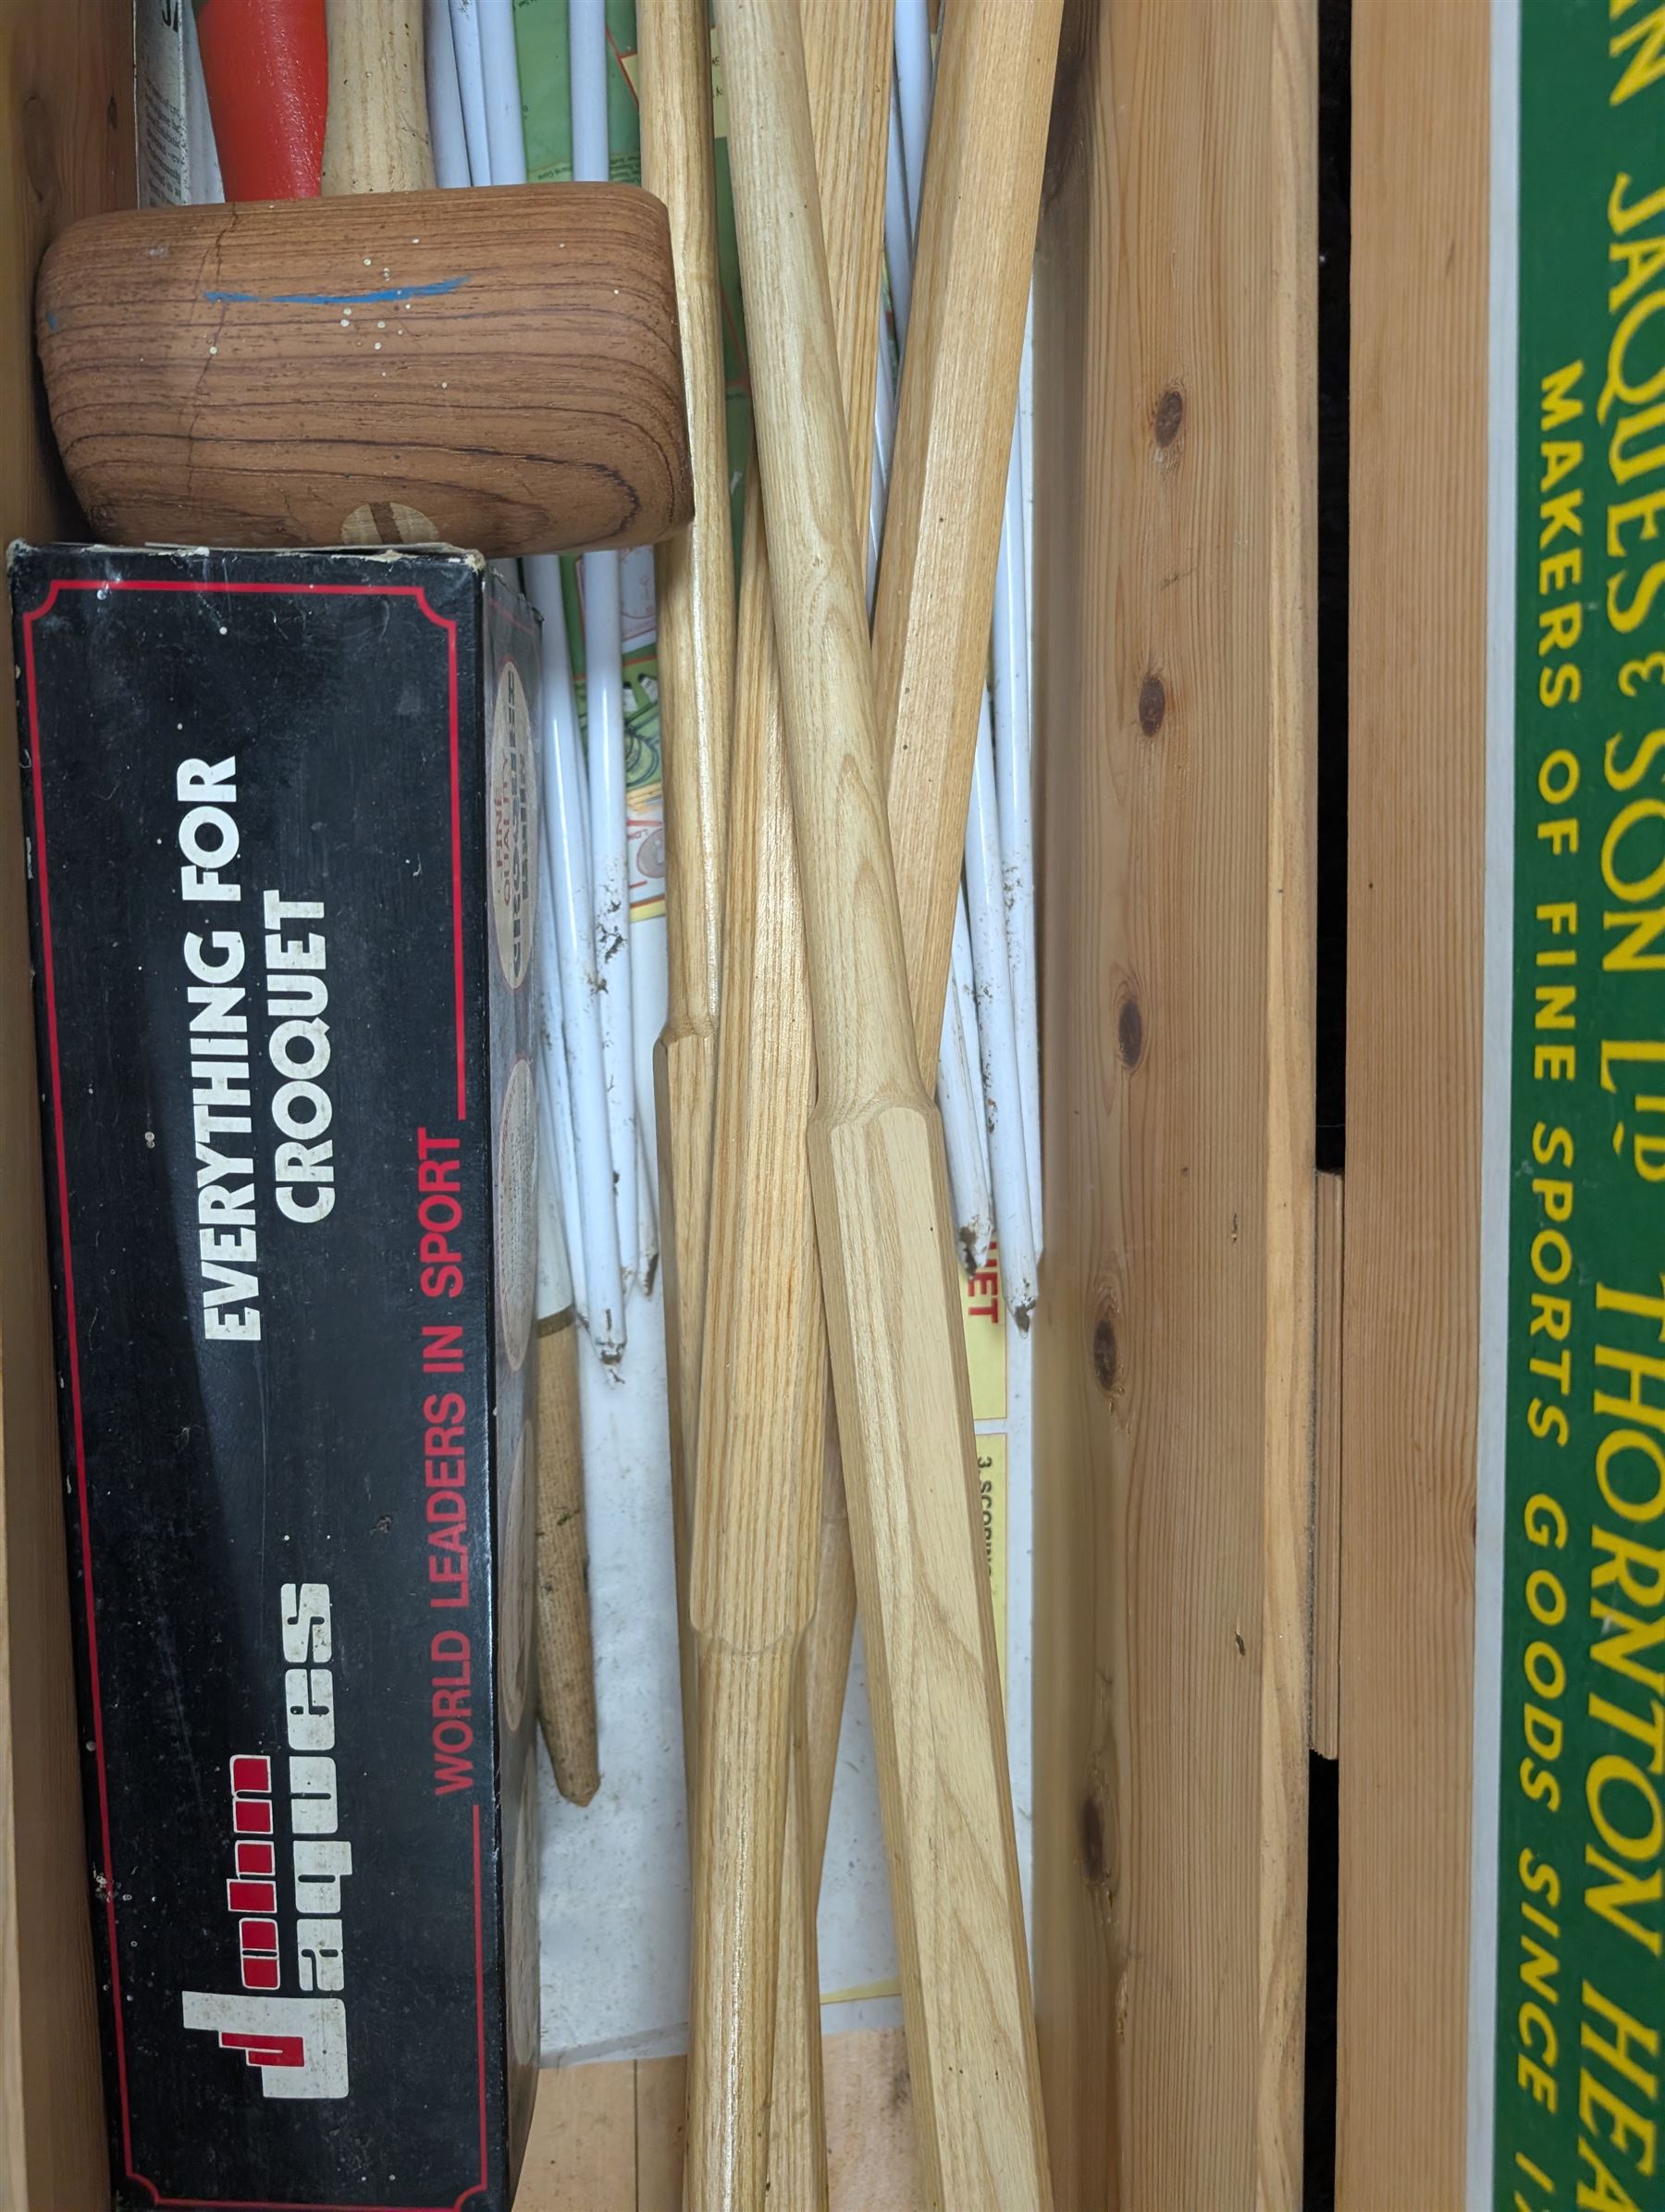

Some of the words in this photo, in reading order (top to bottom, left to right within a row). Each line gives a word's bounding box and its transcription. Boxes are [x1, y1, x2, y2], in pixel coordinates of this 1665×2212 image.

[1598, 174, 1665, 633] JAQUES
[1539, 362, 1584, 707] MAKERS
[176, 755, 240, 903] FOR
[495, 785, 503, 868] FINE
[1537, 750, 1579, 854] OF
[1602, 731, 1665, 971] SON
[263, 889, 336, 1225] CROQUET
[1535, 903, 1578, 1081] FINE
[182, 930, 263, 1342] EVERYTHING
[416, 1125, 464, 1298] SPORT
[421, 1326, 463, 1373] IN
[1527, 1123, 1573, 1446] SPORTS
[423, 1393, 468, 1608] LEADERS
[1585, 1284, 1665, 1955] THORNTON
[432, 1632, 474, 1796] WORLD
[1520, 1495, 1568, 1811] GOODS
[181, 1583, 353, 2099] Jaques
[1518, 1850, 1560, 2112] SINCE
